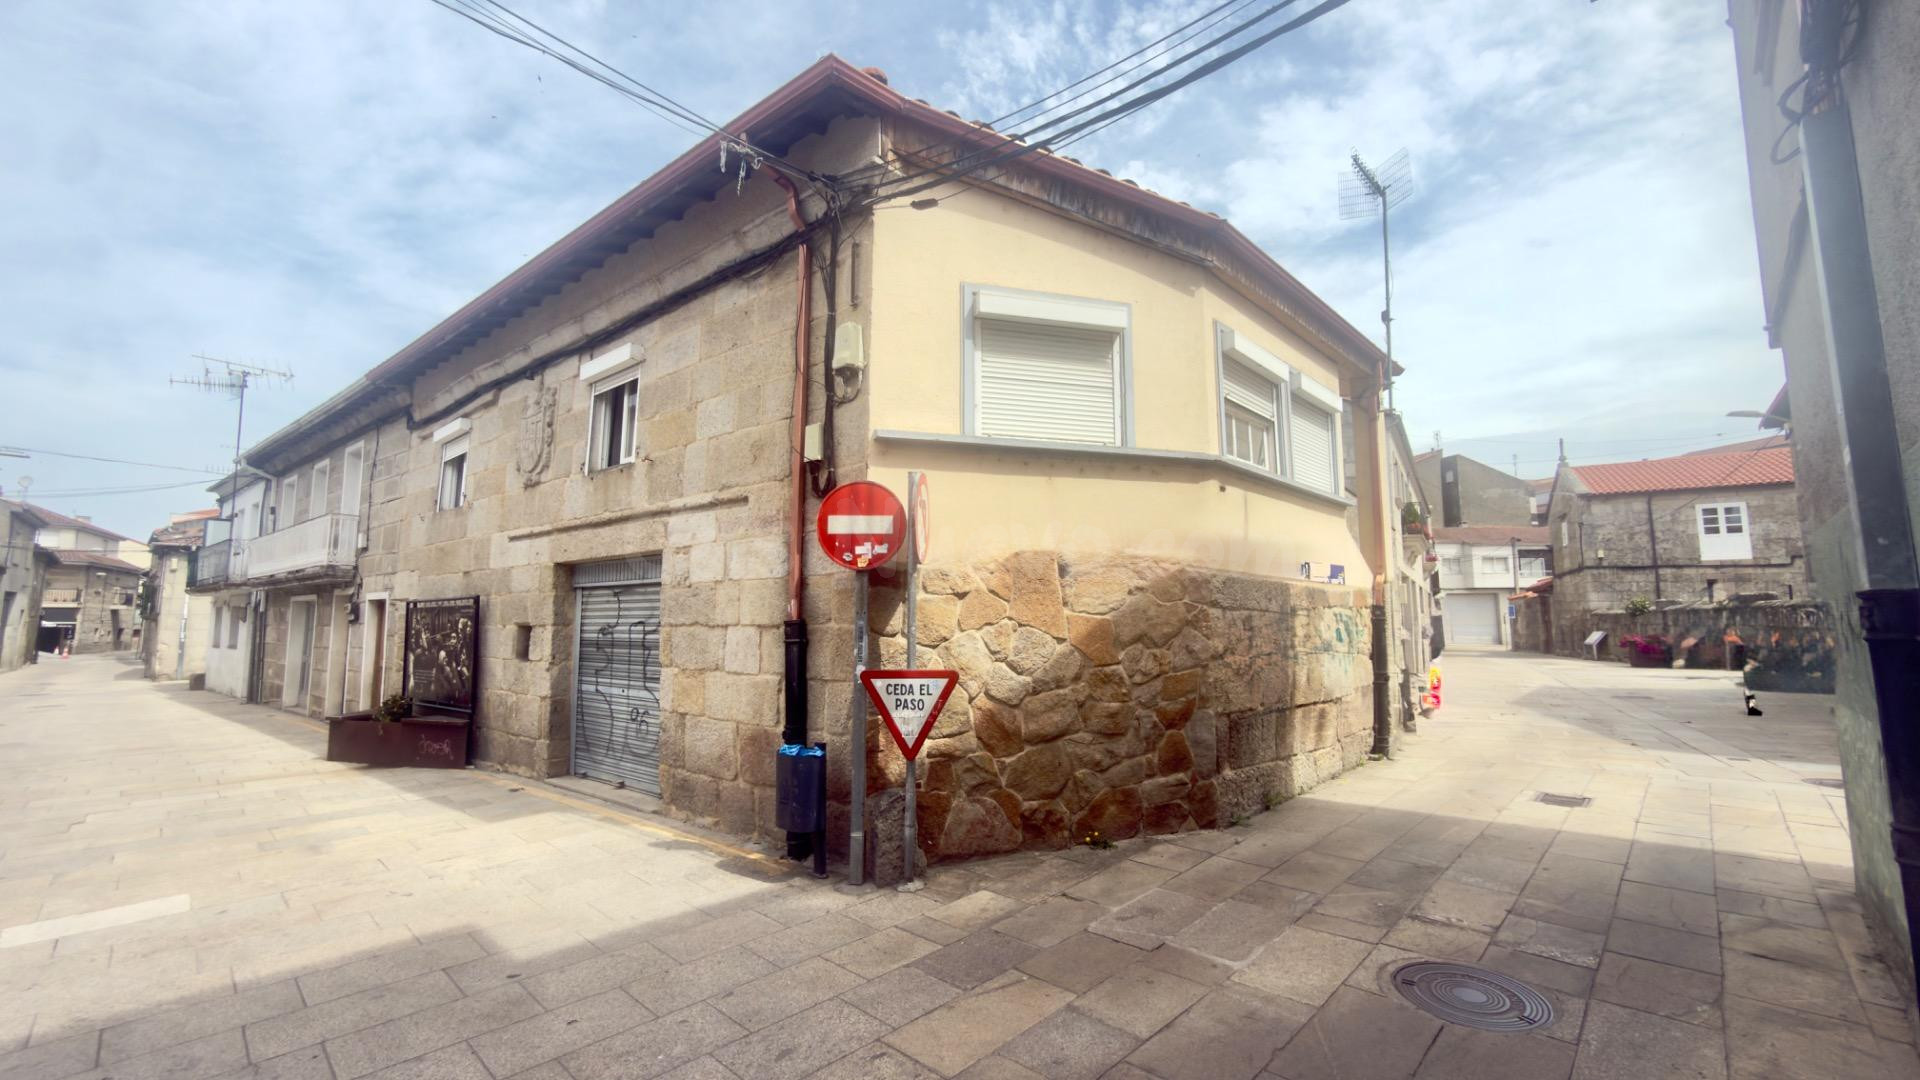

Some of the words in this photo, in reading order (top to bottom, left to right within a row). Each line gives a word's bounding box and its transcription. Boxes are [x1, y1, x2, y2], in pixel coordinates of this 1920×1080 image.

[886, 683, 915, 696] CEDA
[919, 683, 933, 696] EL
[895, 698, 925, 711] PASO
